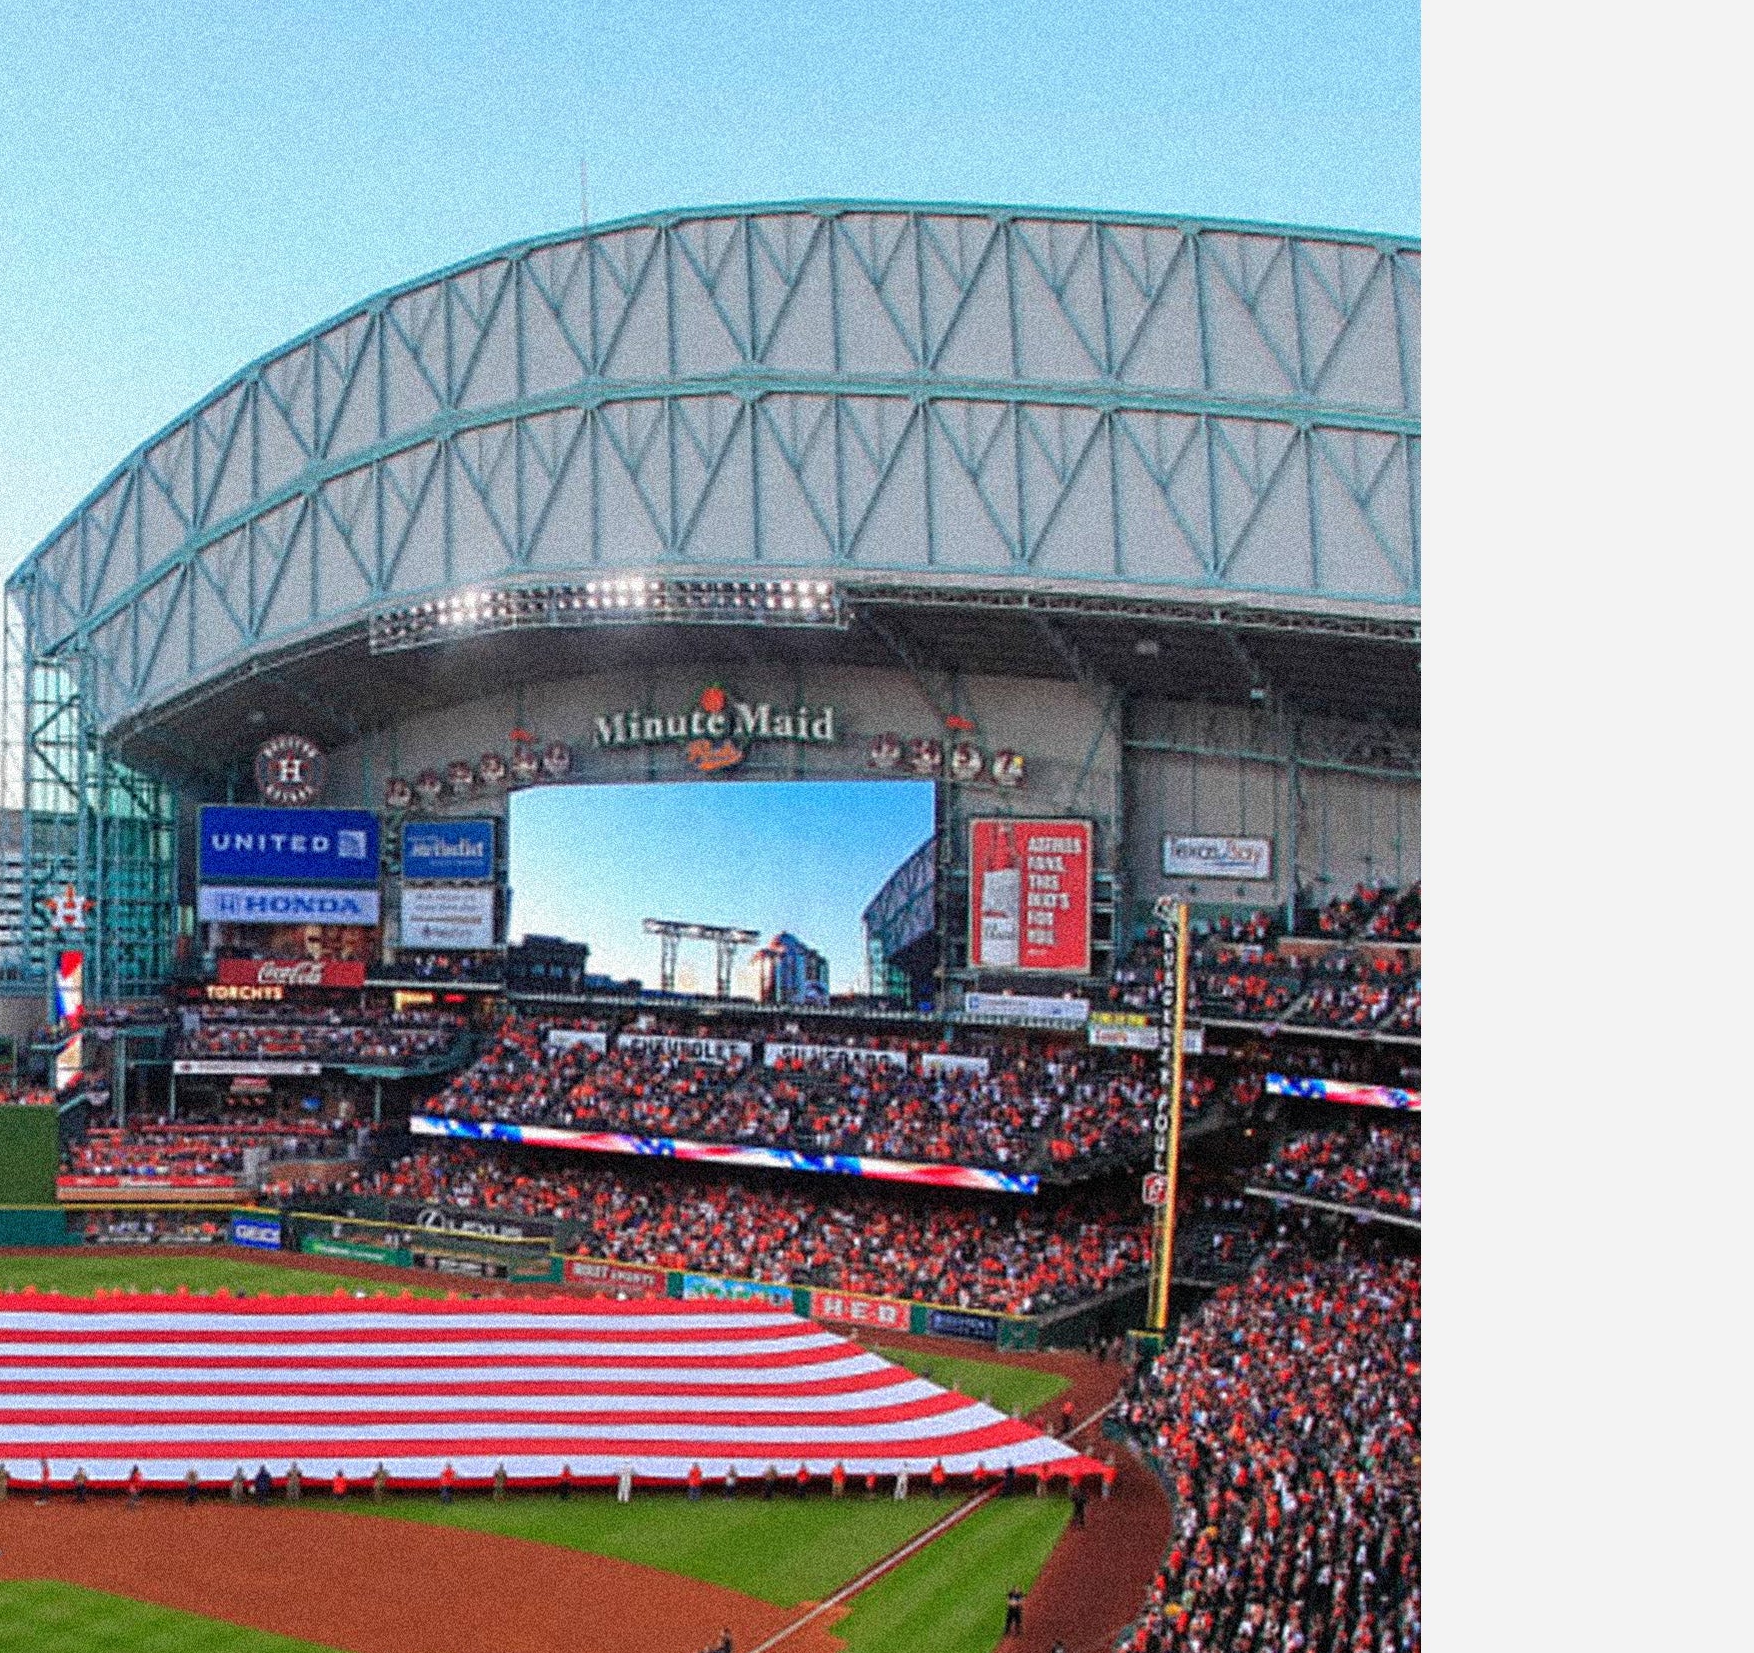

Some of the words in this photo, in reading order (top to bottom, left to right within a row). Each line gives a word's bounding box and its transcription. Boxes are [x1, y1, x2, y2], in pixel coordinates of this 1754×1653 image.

[592, 710, 725, 747] Minute
[733, 703, 836, 742] Maid
[211, 834, 331, 854] UNITED
[245, 894, 362, 915] HONDA
